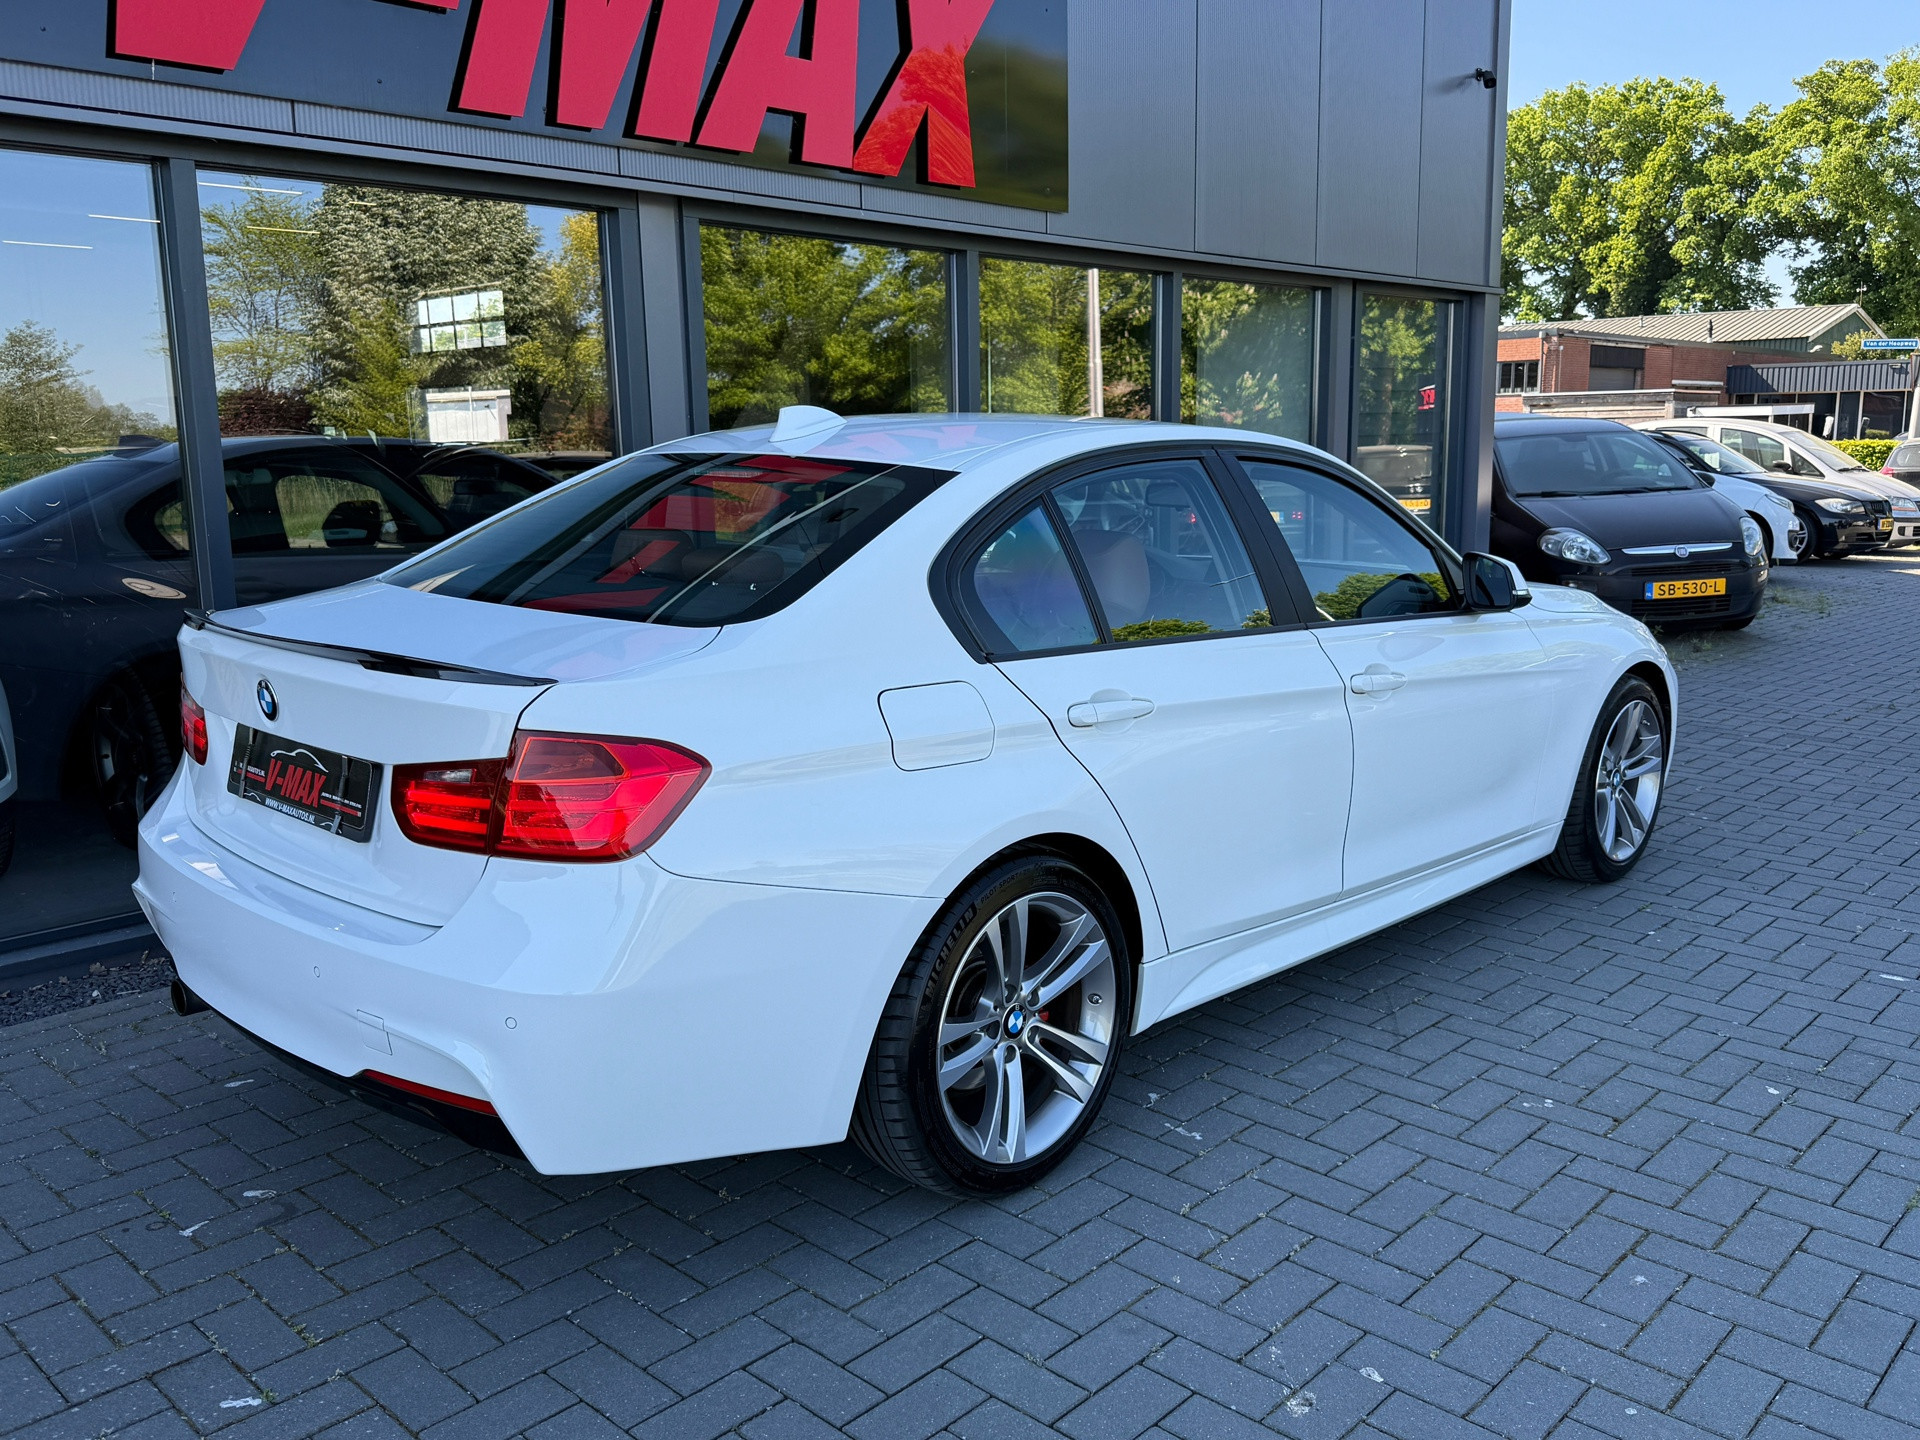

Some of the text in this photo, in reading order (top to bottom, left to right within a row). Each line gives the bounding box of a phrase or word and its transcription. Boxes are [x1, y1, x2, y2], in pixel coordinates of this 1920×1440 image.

[109, 0, 996, 188] MAX
[1657, 580, 1721, 596] SB-530-L
[264, 757, 327, 809] V-MAX
[265, 797, 316, 824] WWW.V-MAXAUTOS.NL
[980, 885, 998, 904] PILOT
[998, 872, 1019, 889] SPORT
[924, 908, 976, 999] MICHELIN
